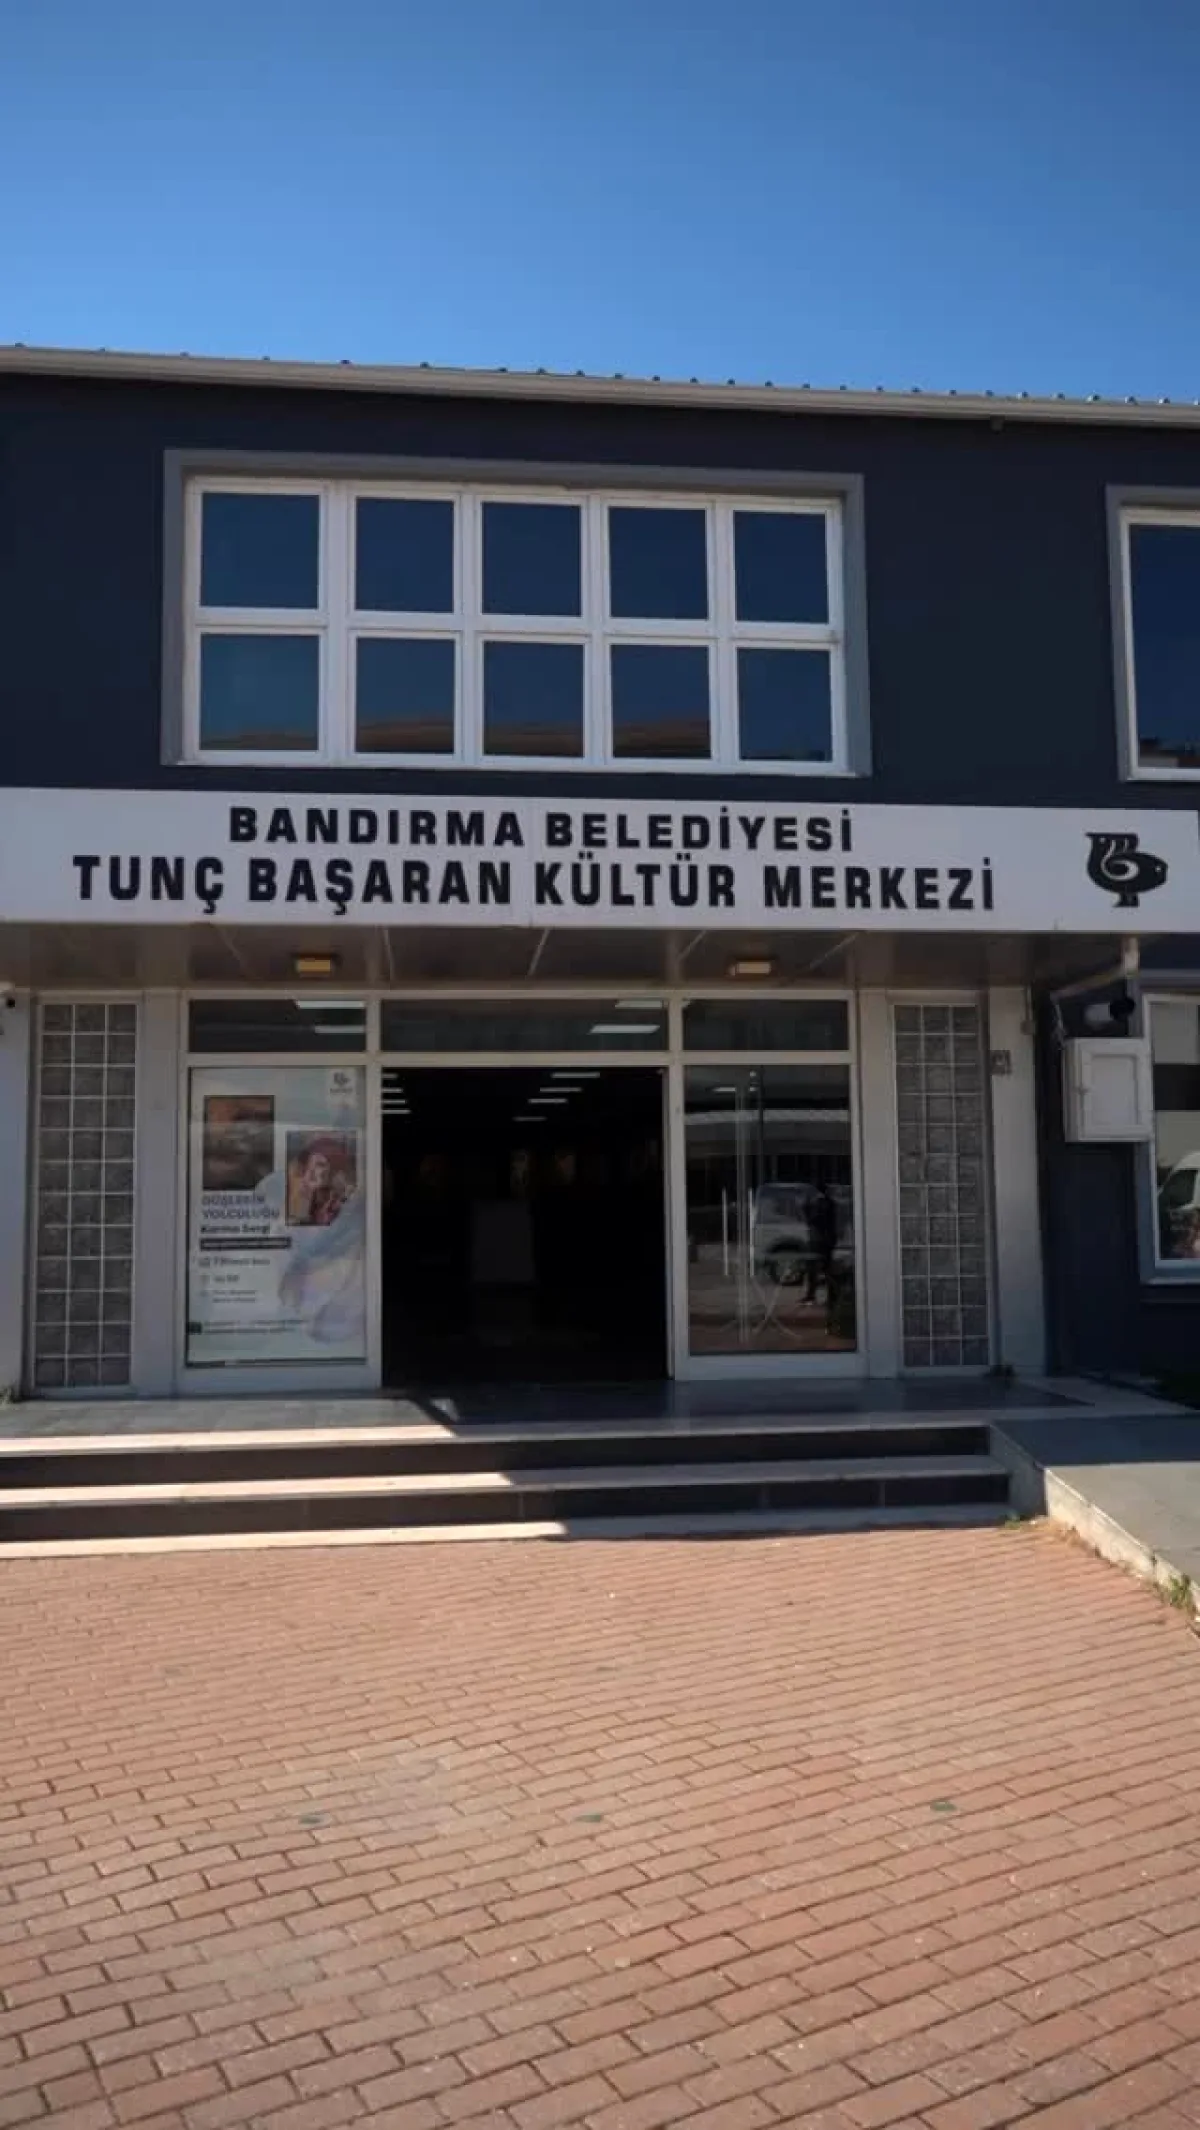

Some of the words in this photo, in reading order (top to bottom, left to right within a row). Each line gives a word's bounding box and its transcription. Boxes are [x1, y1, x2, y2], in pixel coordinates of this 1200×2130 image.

[229, 806, 525, 847] BANDIRMA
[545, 805, 853, 852] BELEDİYESİ
[72, 854, 224, 916] TUNÇ
[248, 857, 511, 916] BAŞARAN
[535, 850, 736, 908] KÜLTÜR
[763, 856, 994, 911] MERKEZİ
